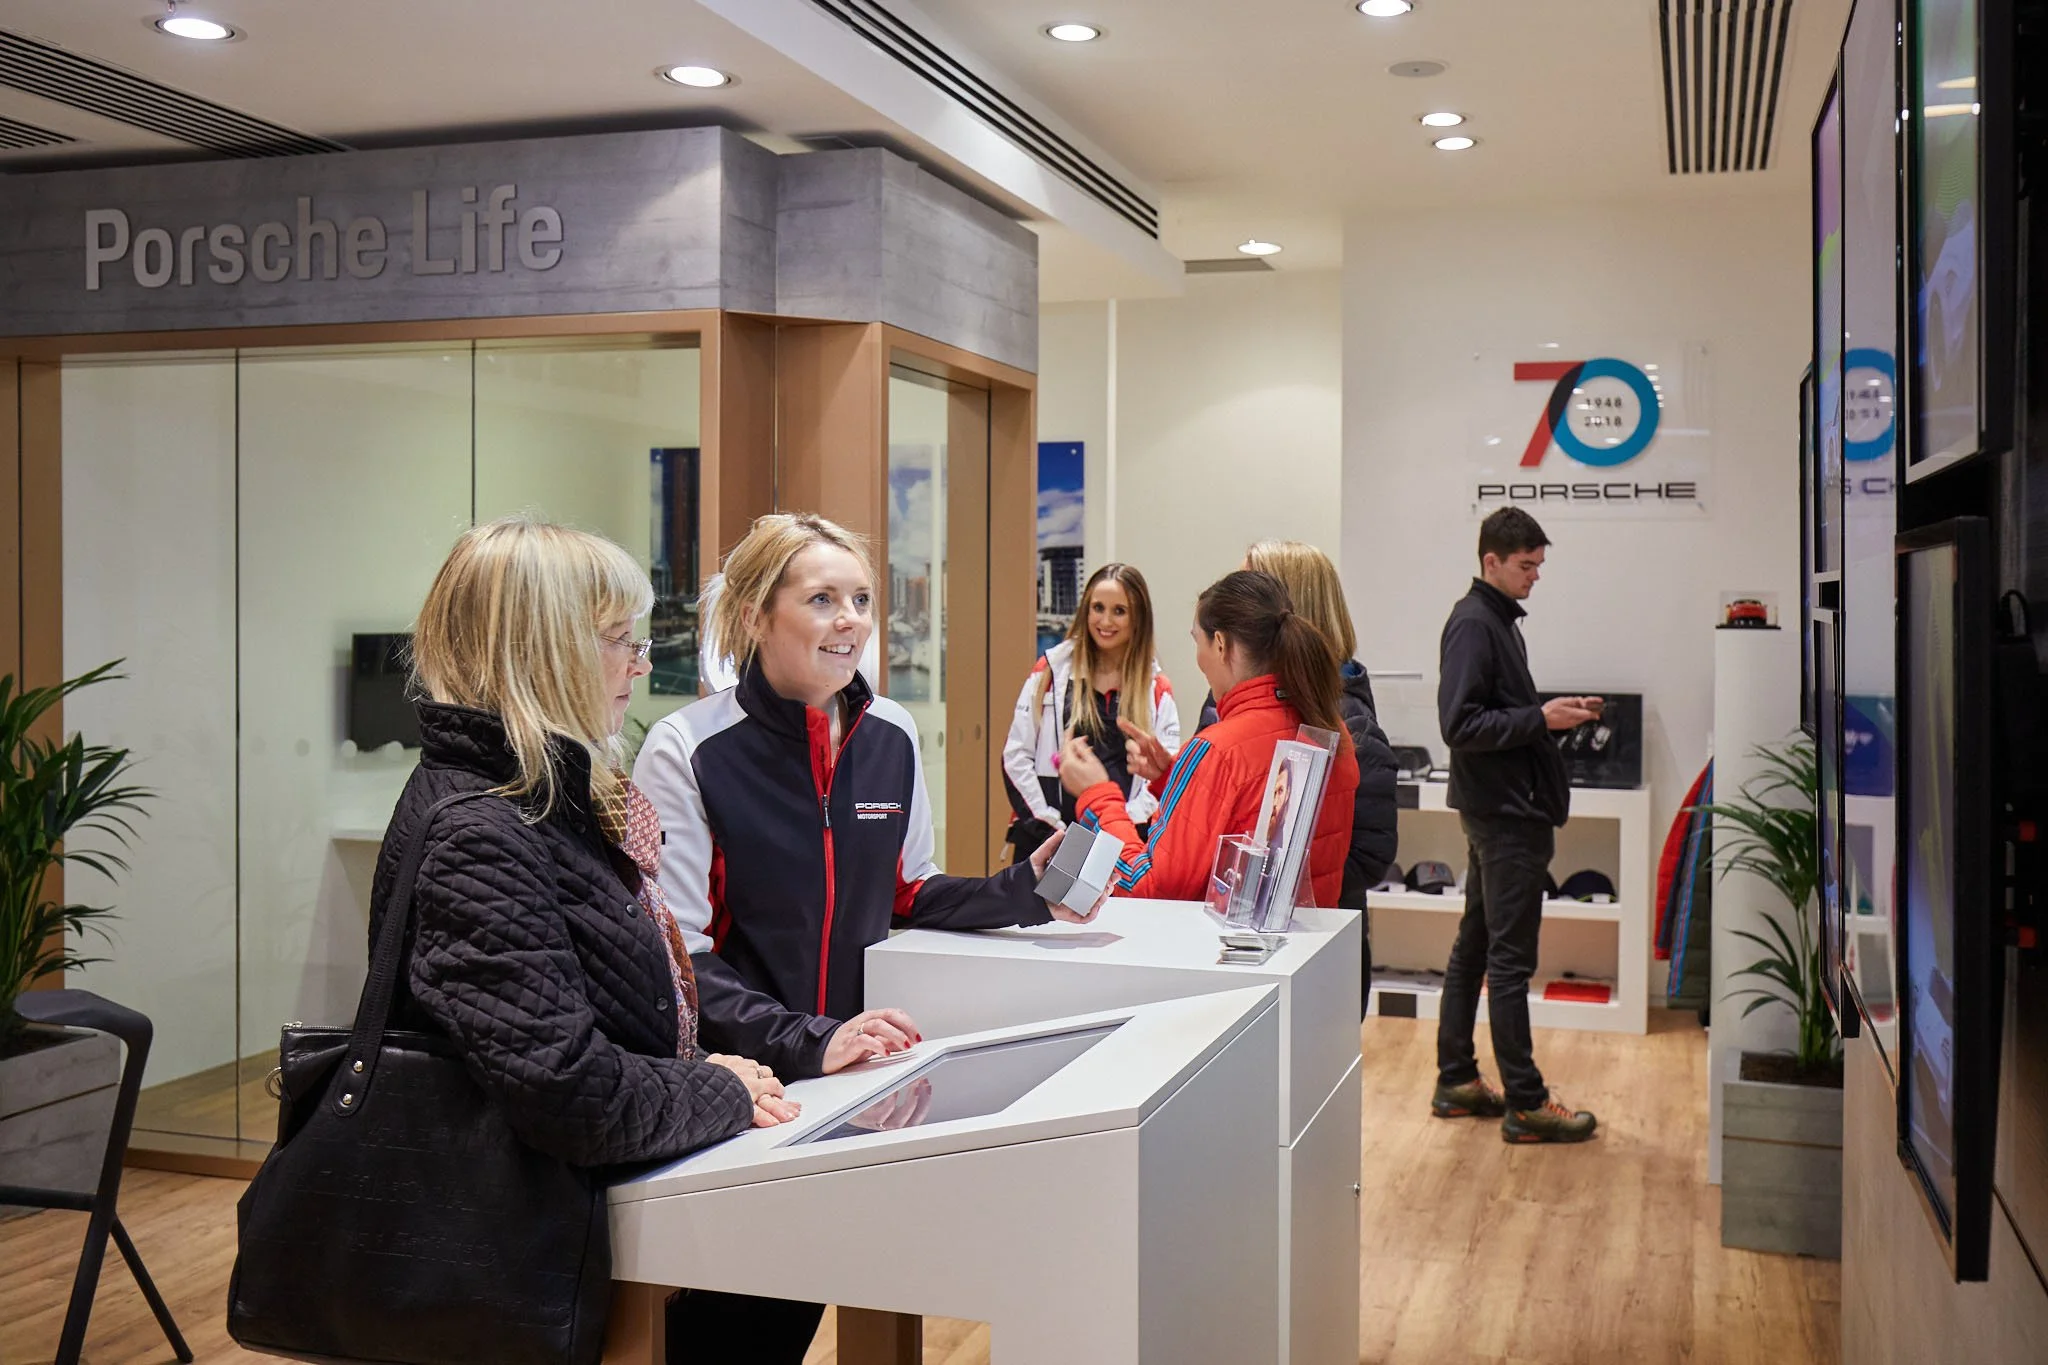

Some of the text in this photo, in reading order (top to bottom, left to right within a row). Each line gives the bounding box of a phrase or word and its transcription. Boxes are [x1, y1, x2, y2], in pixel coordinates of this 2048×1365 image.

[85, 184, 563, 291] Porsche Life
[1585, 397, 1622, 407] 1948
[1514, 358, 1660, 467] 70
[1584, 416, 1622, 427] 2018
[1478, 482, 1697, 500] PORSCHE
[855, 802, 902, 810] PORSCH
